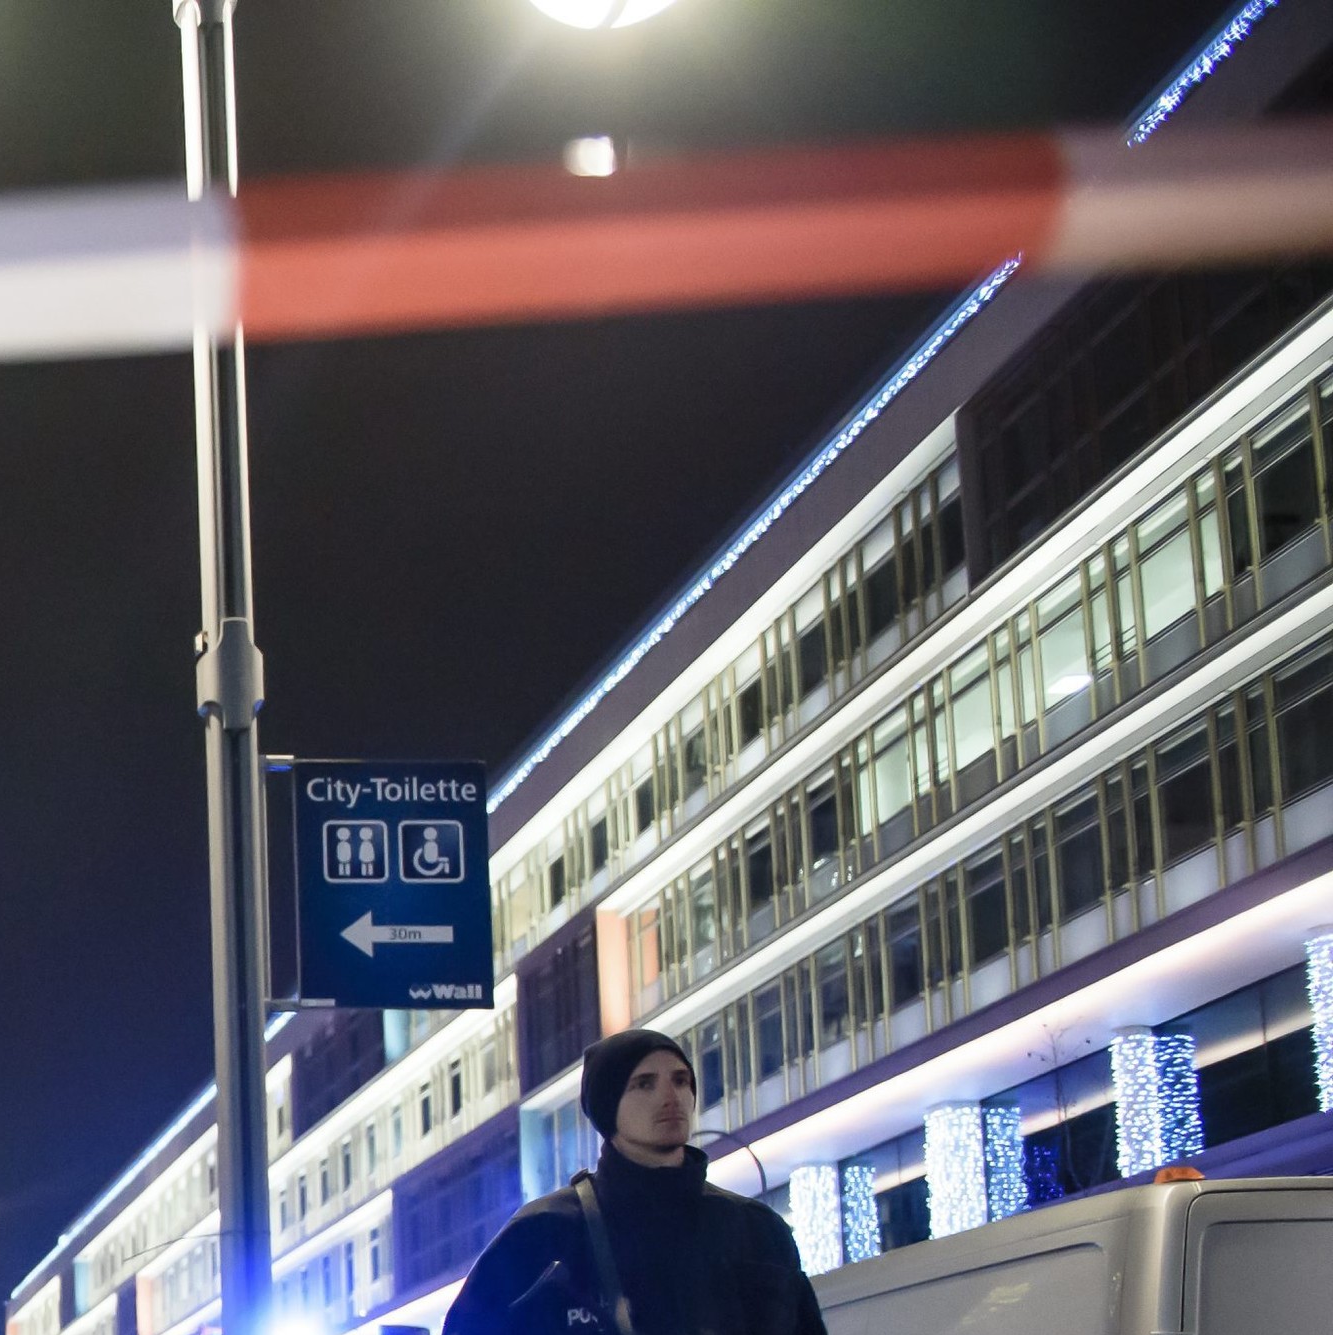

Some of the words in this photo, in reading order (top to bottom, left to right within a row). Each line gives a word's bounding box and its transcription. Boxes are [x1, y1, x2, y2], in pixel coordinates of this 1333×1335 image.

[306, 776, 477, 808] City-Toilette
[389, 927, 422, 940] 30m
[432, 983, 483, 1000] Wall
